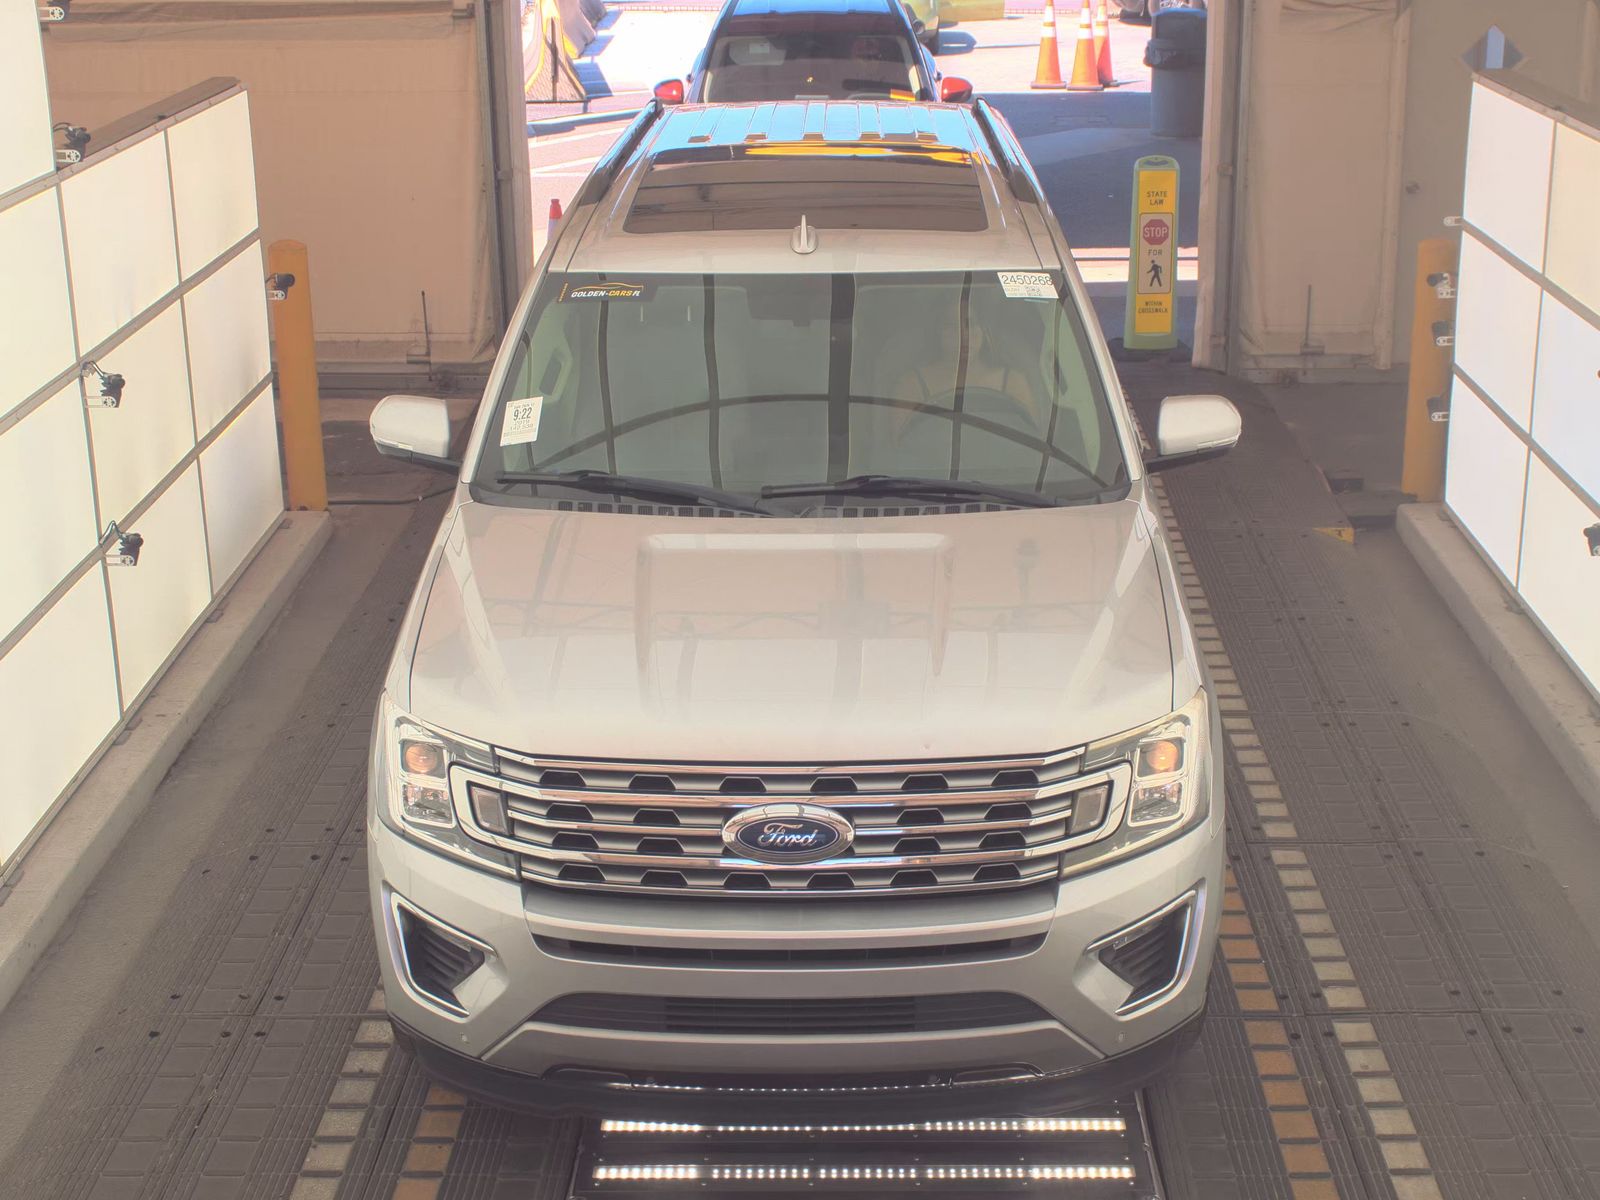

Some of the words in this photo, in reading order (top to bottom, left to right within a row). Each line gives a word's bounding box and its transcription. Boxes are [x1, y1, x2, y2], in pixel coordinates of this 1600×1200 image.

[1144, 227, 1168, 238] STOP
[1001, 274, 1053, 286] 2450268
[513, 407, 533, 421] 9:22
[757, 822, 819, 847] Ford
